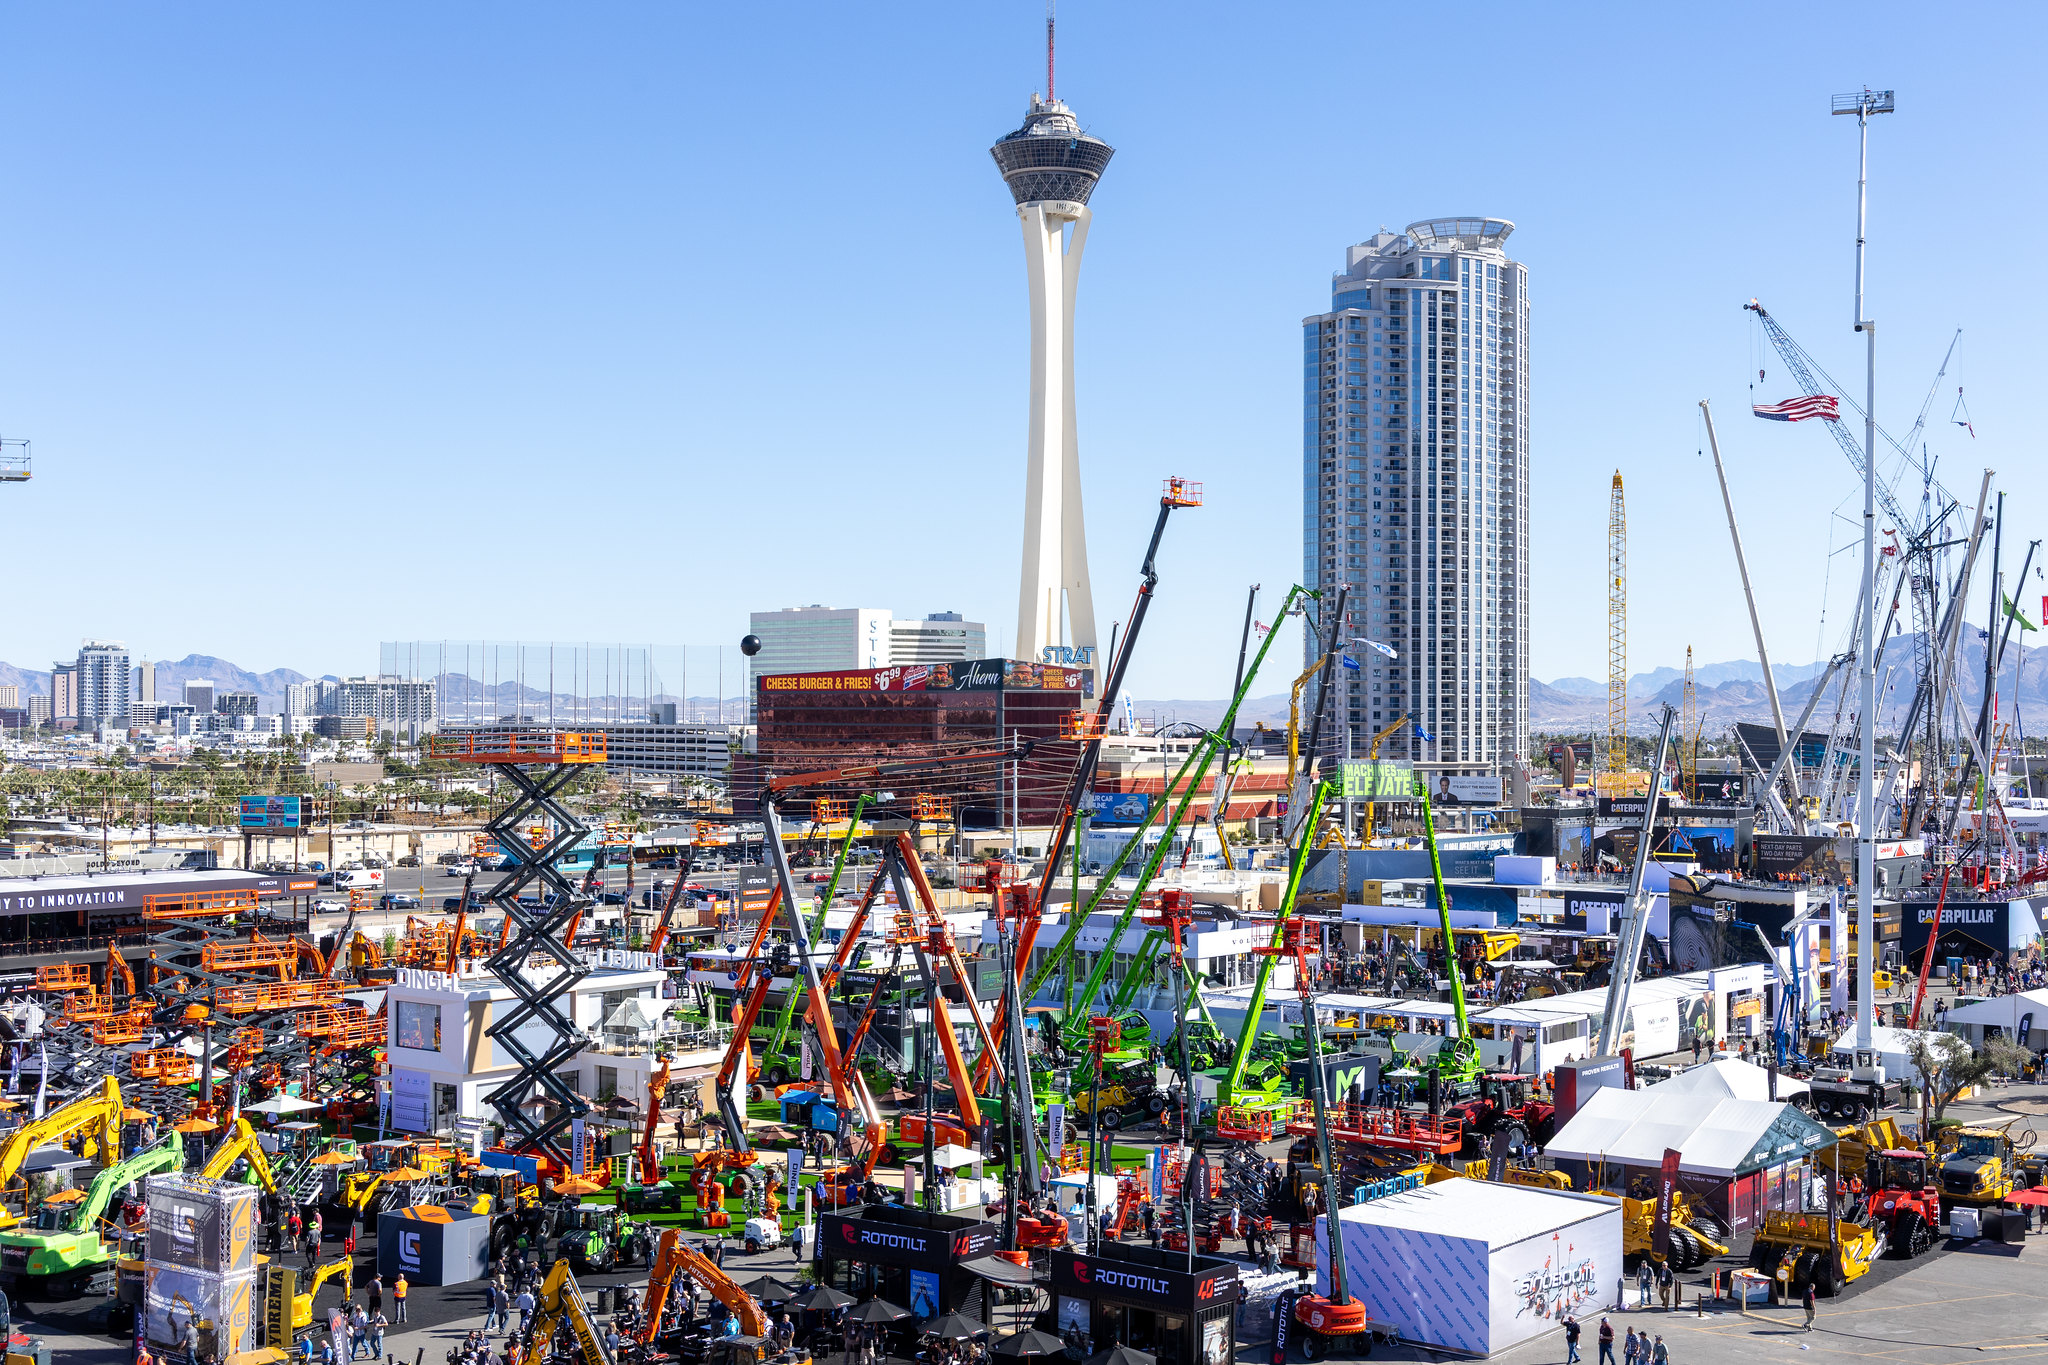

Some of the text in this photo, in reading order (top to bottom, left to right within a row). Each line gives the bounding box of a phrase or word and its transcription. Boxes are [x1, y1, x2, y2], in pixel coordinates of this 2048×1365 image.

[1042, 645, 1095, 665] STRAT
[956, 662, 1001, 691] Ahern
[1043, 668, 1063, 676] CHEESE
[766, 676, 872, 690] CHEESE BURGER & FRIES!
[1048, 681, 1066, 689] FRIES!
[1344, 764, 1412, 778] MACHINES THAT
[1344, 777, 1413, 796] ELEVATE
[1611, 803, 1647, 813] CATERPIL
[1760, 843, 1785, 851] NEXT-DAY
[1454, 866, 1478, 875] SEE IT
[18, 896, 35, 909] TO
[41, 890, 125, 907] INNOVATION
[1191, 909, 1213, 917] VOLVO
[1917, 909, 1994, 924] CATERPILLAR
[1074, 935, 1109, 943] OLVO
[396, 967, 460, 993] DINGLI
[852, 975, 876, 983] MERLO
[1365, 1039, 1390, 1049] AMBITION
[1581, 1062, 1620, 1077] PROVEN RESULTS
[1053, 1116, 1062, 1145] DINGLI
[575, 1132, 583, 1162] DINGLI
[790, 1162, 799, 1195] DINGLI
[1511, 1172, 1541, 1183] K-TEC
[1663, 1180, 1671, 1212] ASHLAND
[861, 1230, 927, 1252] ROTOTILT
[688, 1264, 716, 1289] HITACHI
[1095, 1268, 1170, 1295] ROTOTILT
[268, 1270, 284, 1349] YDREMA
[1277, 1296, 1289, 1349] ROTOTILT
